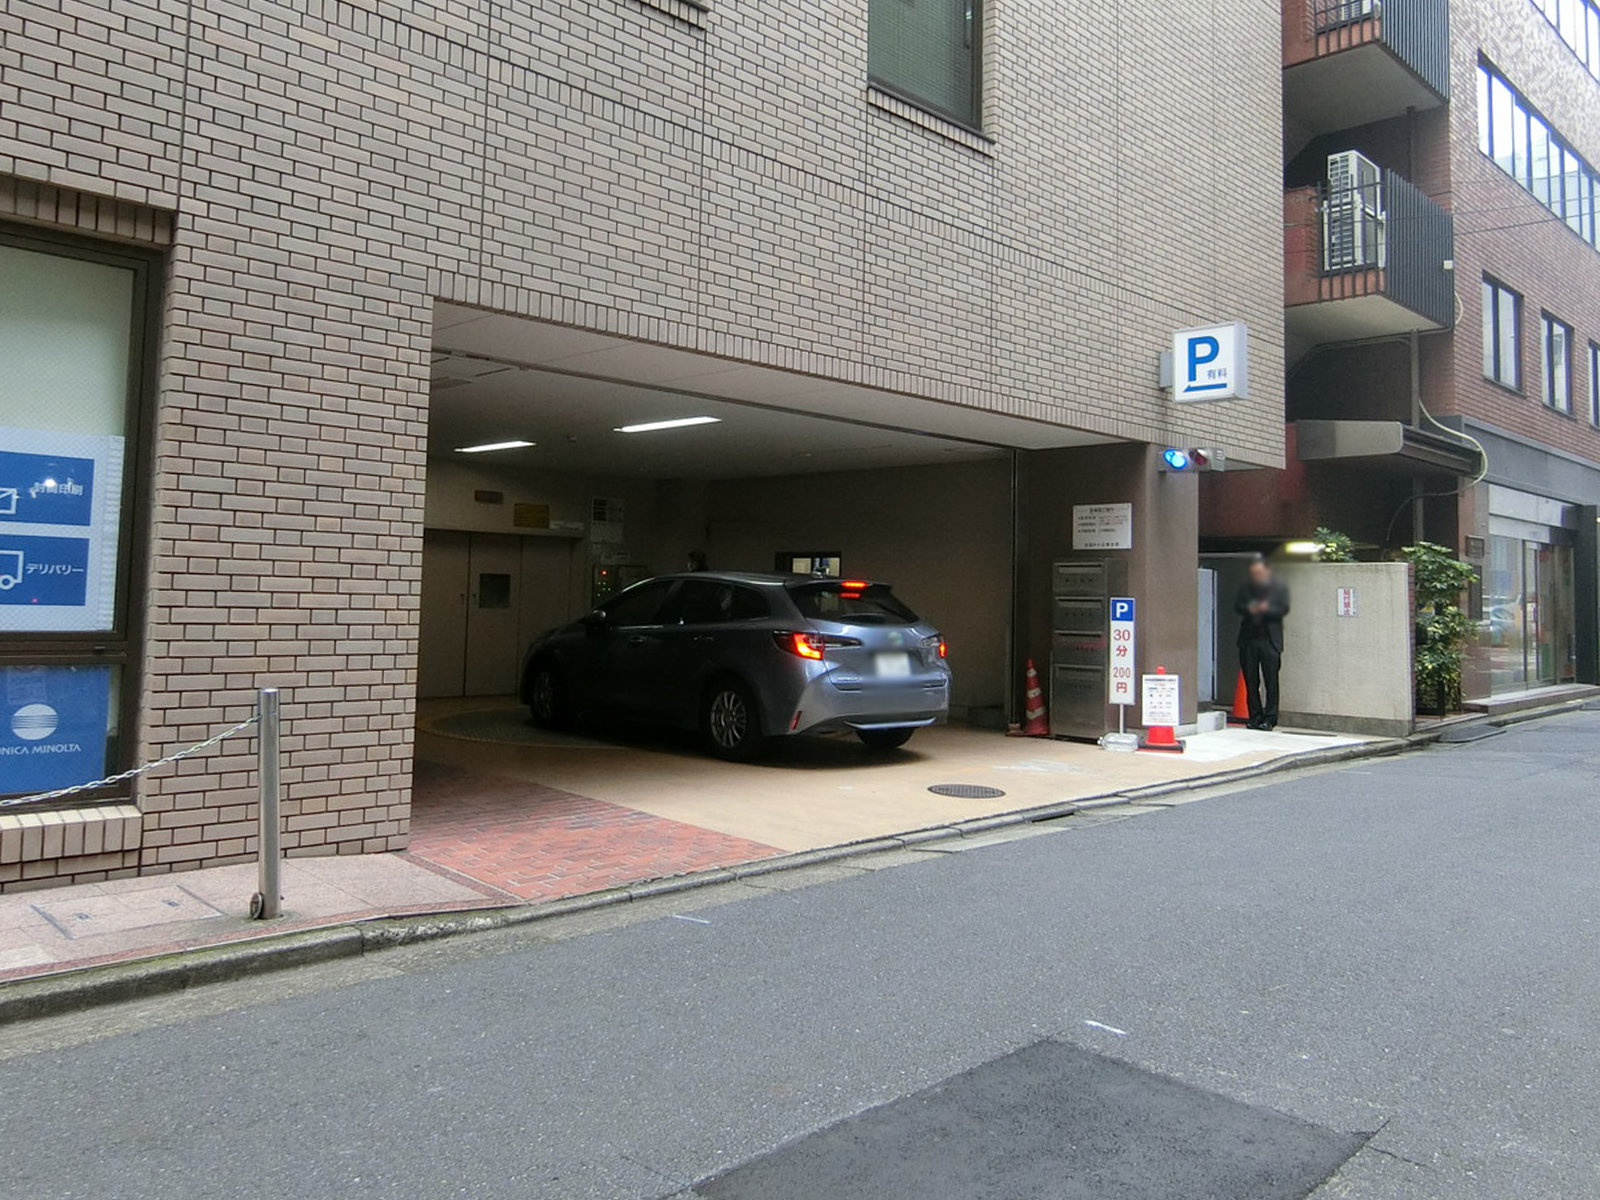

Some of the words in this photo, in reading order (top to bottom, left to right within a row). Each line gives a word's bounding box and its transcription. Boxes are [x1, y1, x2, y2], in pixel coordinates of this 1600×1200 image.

[1188, 336, 1219, 382] P
[26, 563, 84, 574] デリバリー
[1116, 602, 1128, 618] P
[1113, 629, 1131, 641] 30
[1116, 645, 1128, 657] 分
[1113, 667, 1131, 678] 200
[1116, 682, 1127, 693] 円
[0, 746, 29, 755] NICA
[31, 743, 81, 753] MINOLTA
